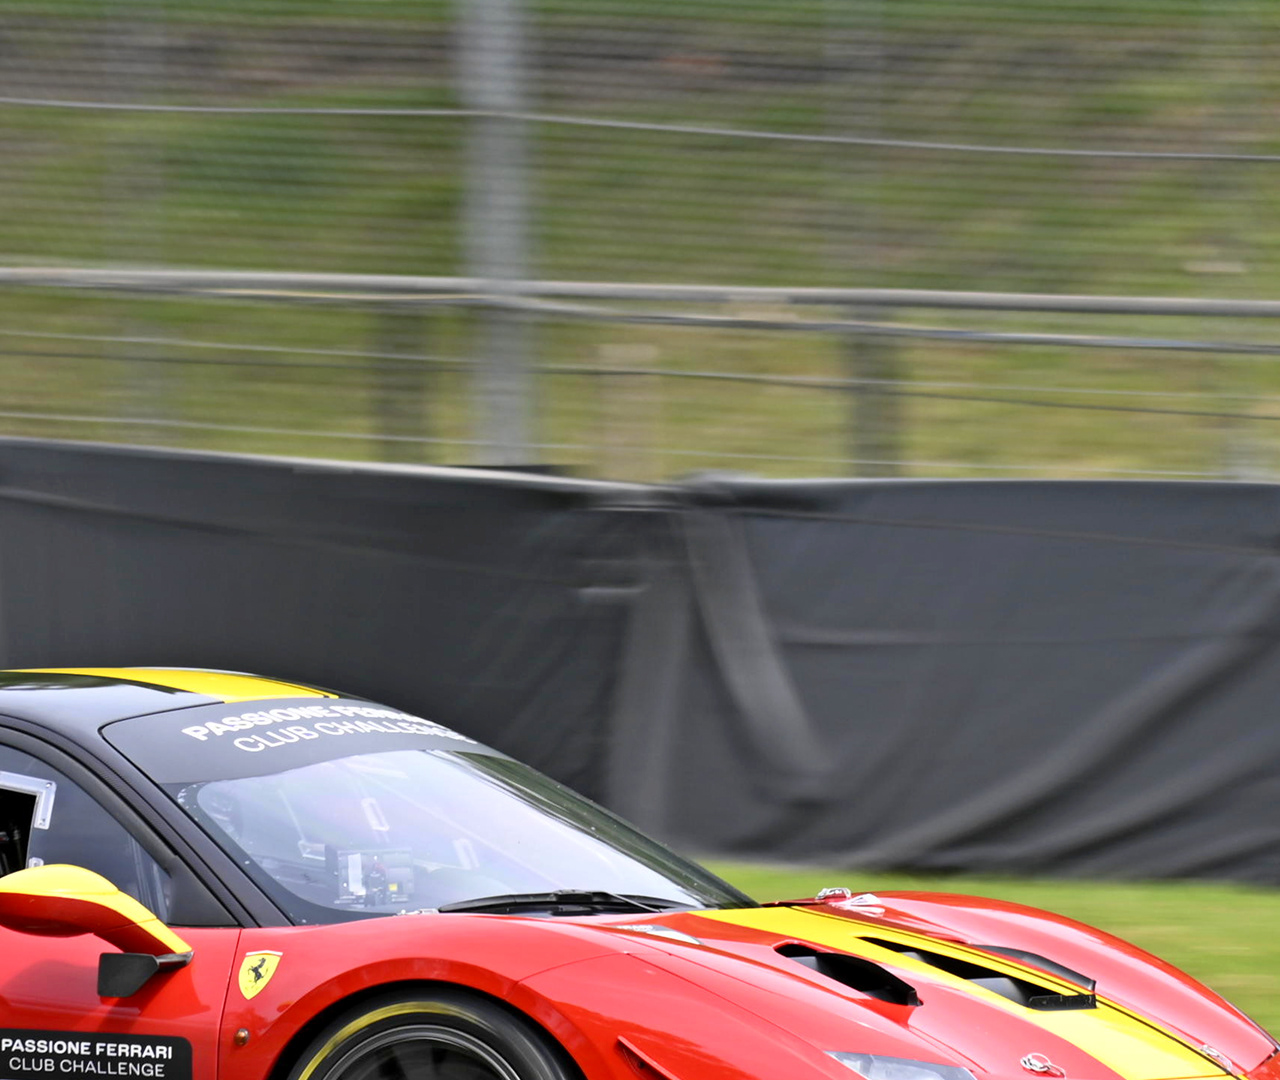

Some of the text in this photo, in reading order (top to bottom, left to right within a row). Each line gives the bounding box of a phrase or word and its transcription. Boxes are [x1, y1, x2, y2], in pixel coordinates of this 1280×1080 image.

[181, 705, 341, 741] PASSIONE
[233, 724, 319, 752] CLUB
[1, 1038, 173, 1060] PASSIONE FERRARI
[9, 1056, 166, 1078] CLUB CHALLENGE
